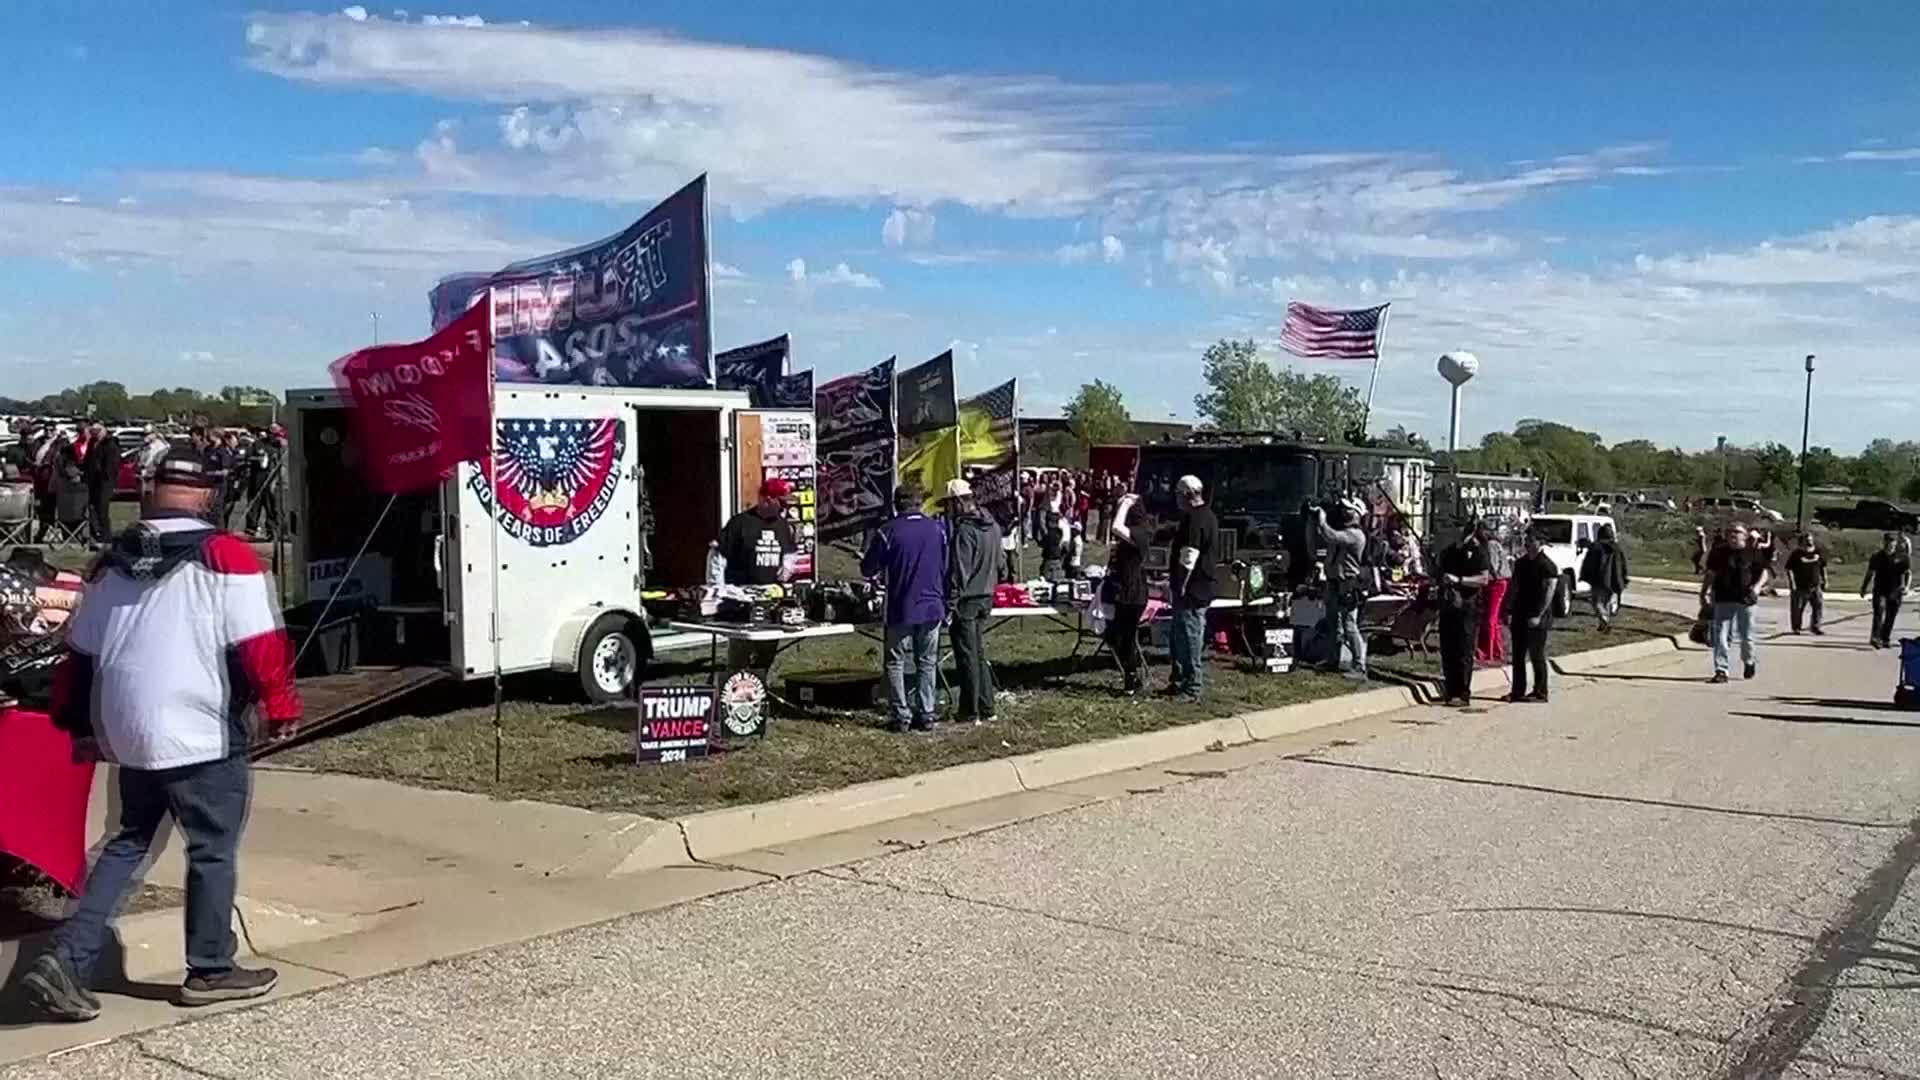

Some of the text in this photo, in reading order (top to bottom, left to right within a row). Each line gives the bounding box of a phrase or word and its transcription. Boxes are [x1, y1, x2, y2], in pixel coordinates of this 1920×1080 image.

[496, 503, 542, 542] YEARS
[545, 527, 563, 543] OF
[643, 696, 711, 719] TRUMP
[650, 721, 703, 738] VANCE
